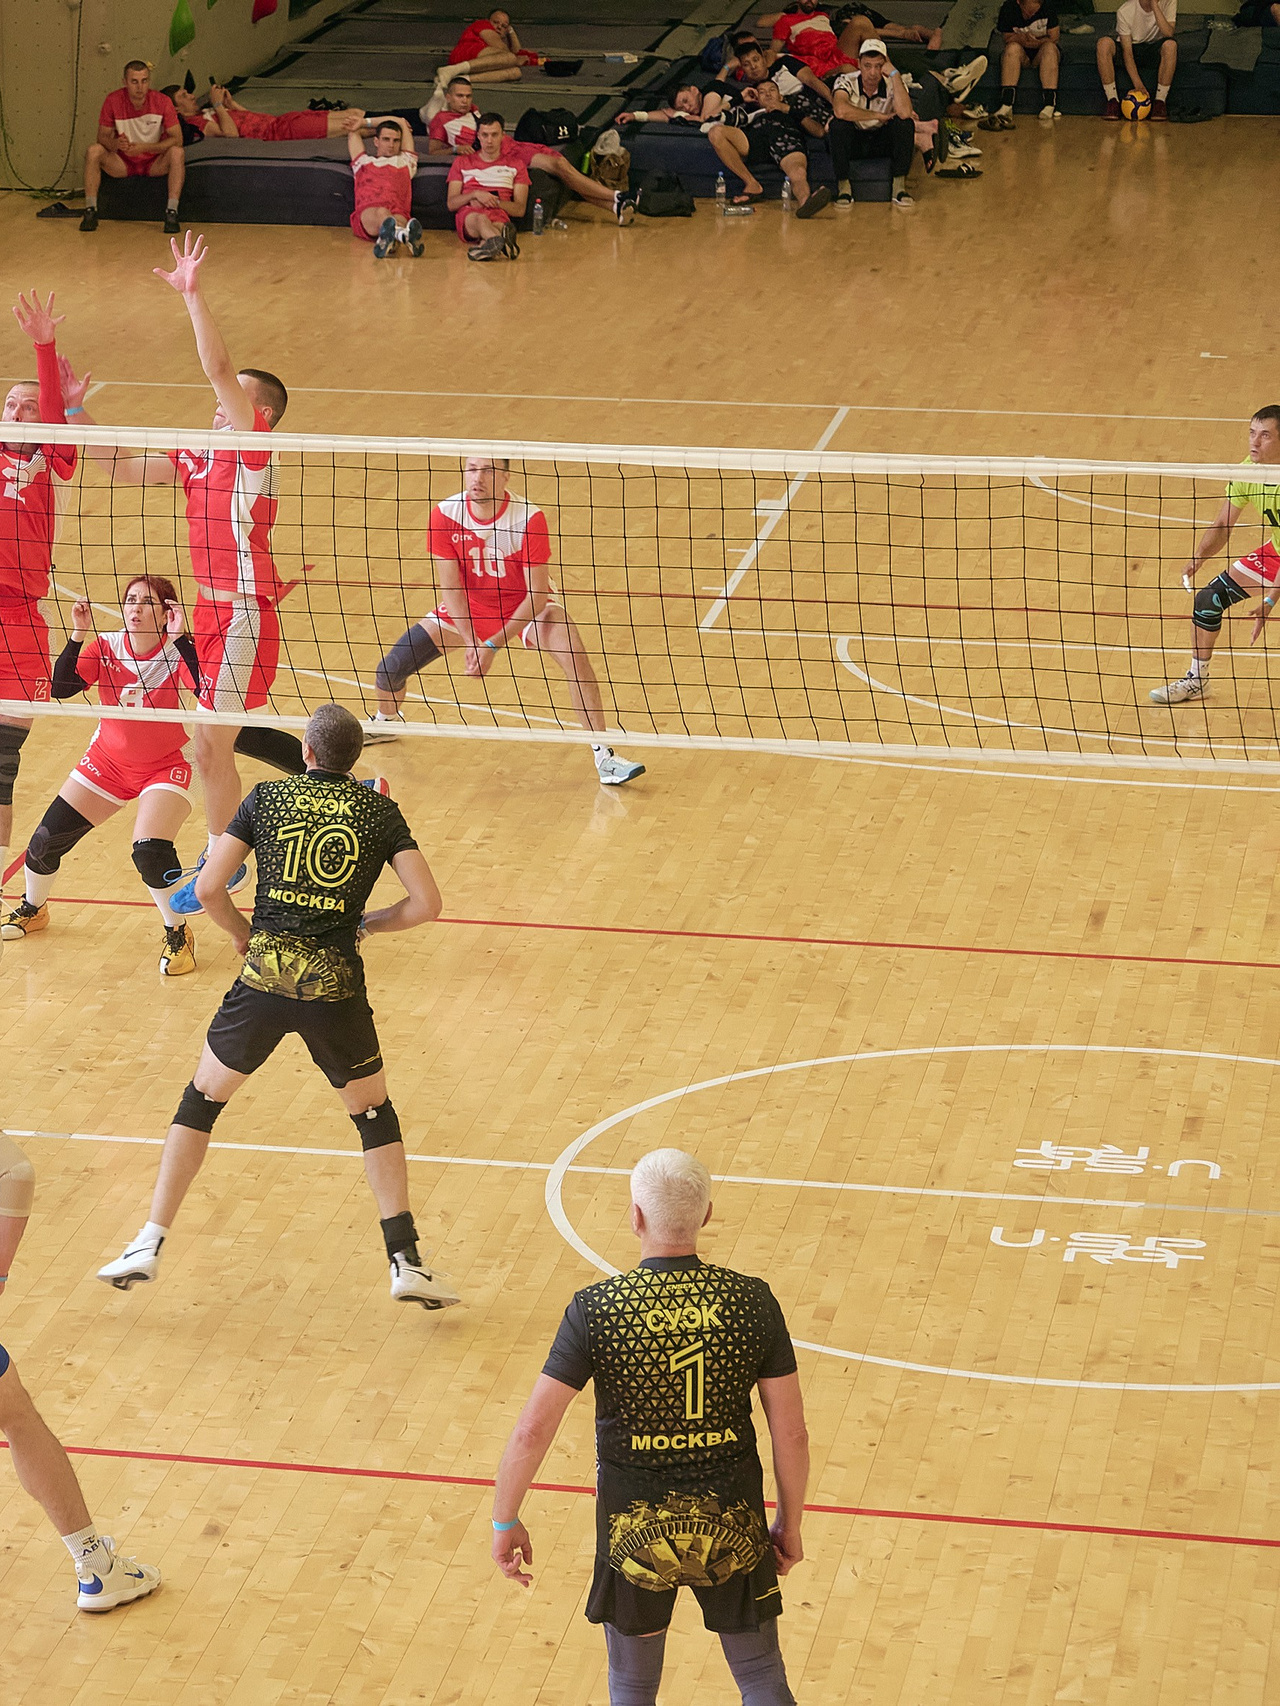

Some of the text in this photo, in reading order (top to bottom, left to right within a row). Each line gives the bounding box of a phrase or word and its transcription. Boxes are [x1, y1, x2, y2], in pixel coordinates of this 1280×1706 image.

[33, 676, 48, 700] 2
[169, 766, 188, 784] 8
[295, 794, 355, 817] СУЭК
[276, 820, 360, 888] 10
[268, 888, 346, 913] МОСКВА
[645, 1303, 723, 1333] СУЭК
[669, 1339, 706, 1421] 1
[631, 1427, 739, 1451] МОСКВА
